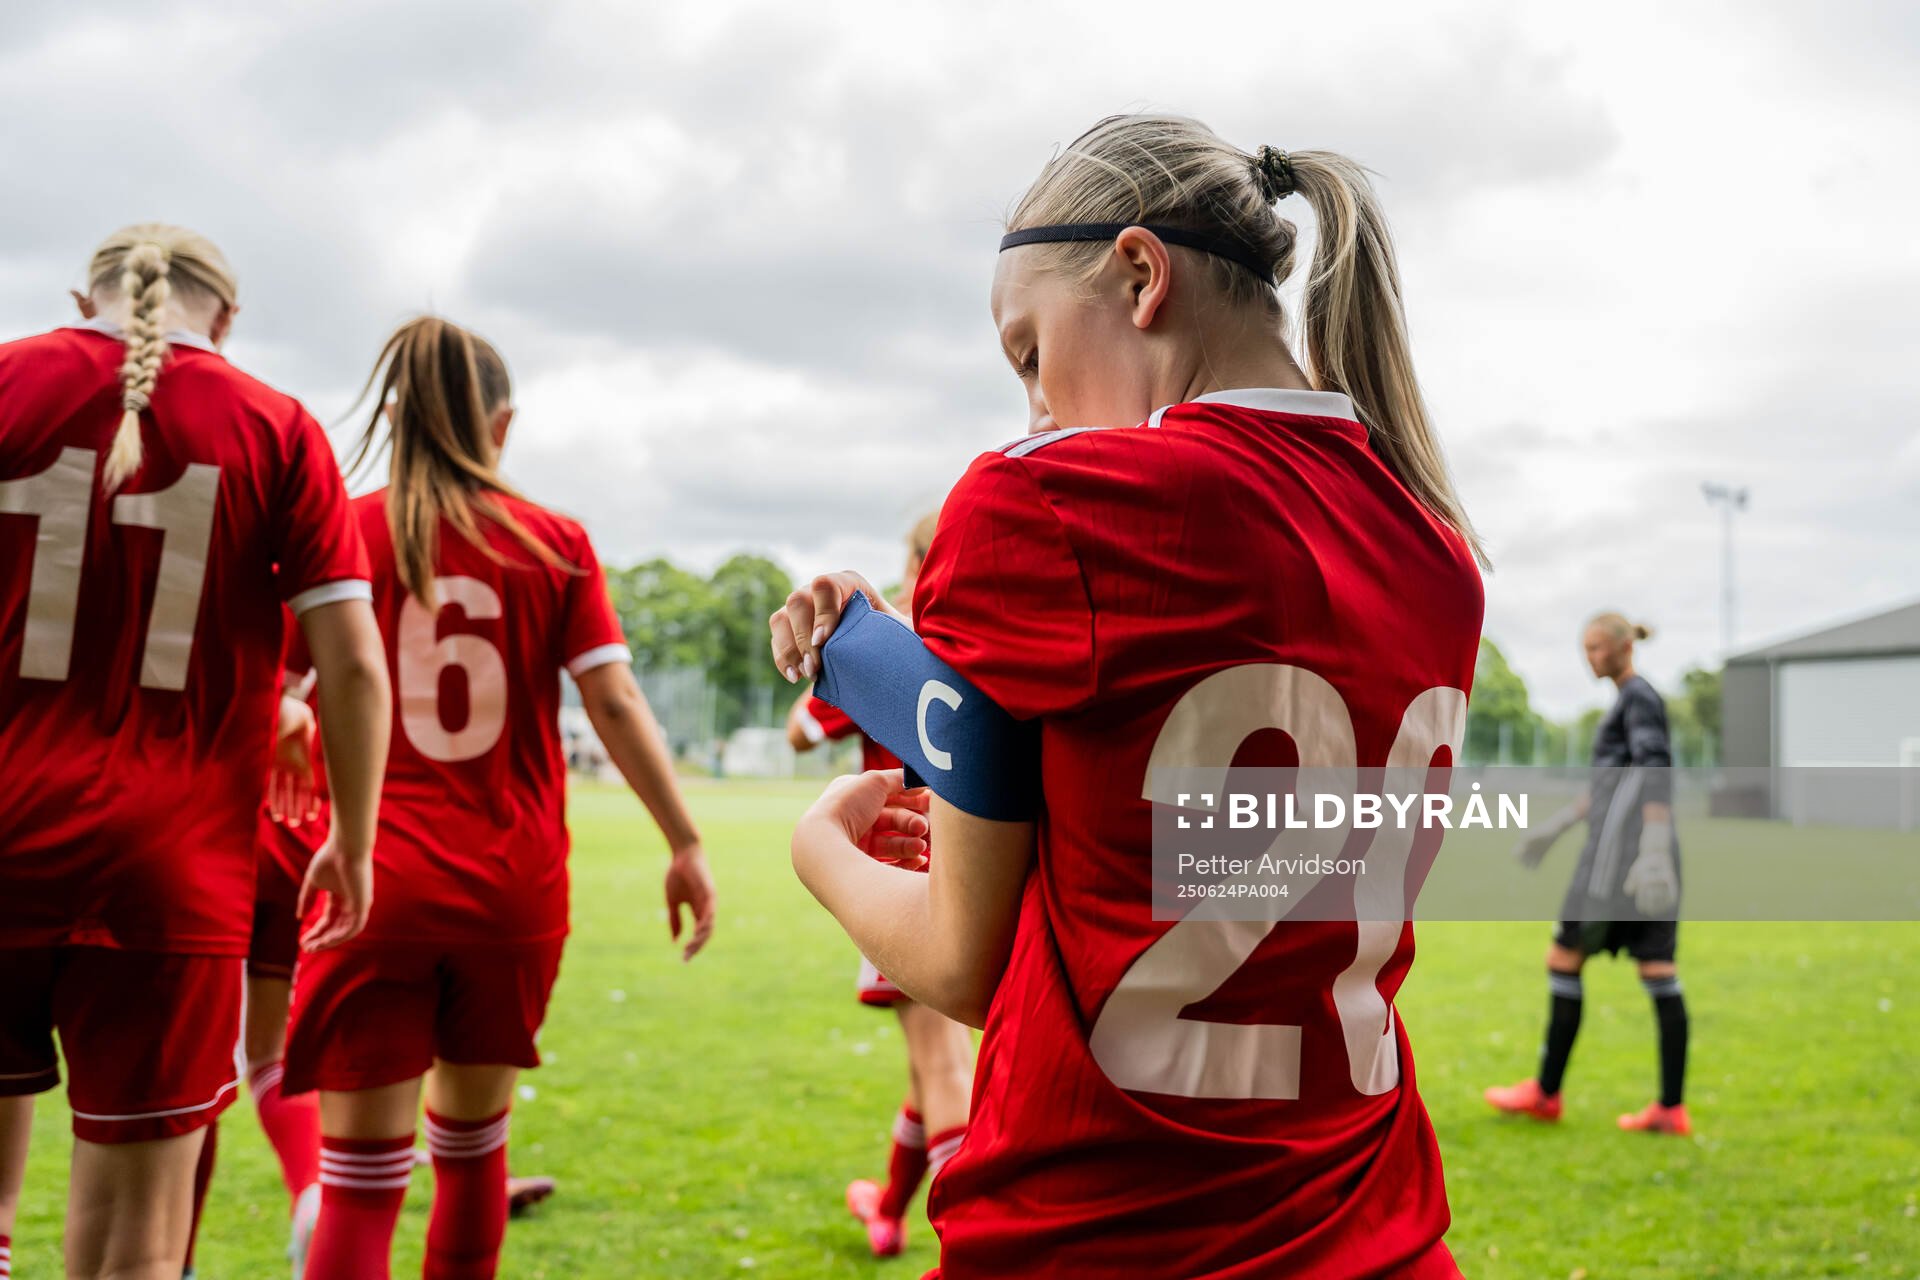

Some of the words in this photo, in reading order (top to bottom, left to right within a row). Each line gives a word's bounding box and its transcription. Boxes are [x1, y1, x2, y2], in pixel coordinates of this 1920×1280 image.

[0, 447, 221, 691] 11
[399, 575, 508, 762] 6
[916, 679, 963, 771] C
